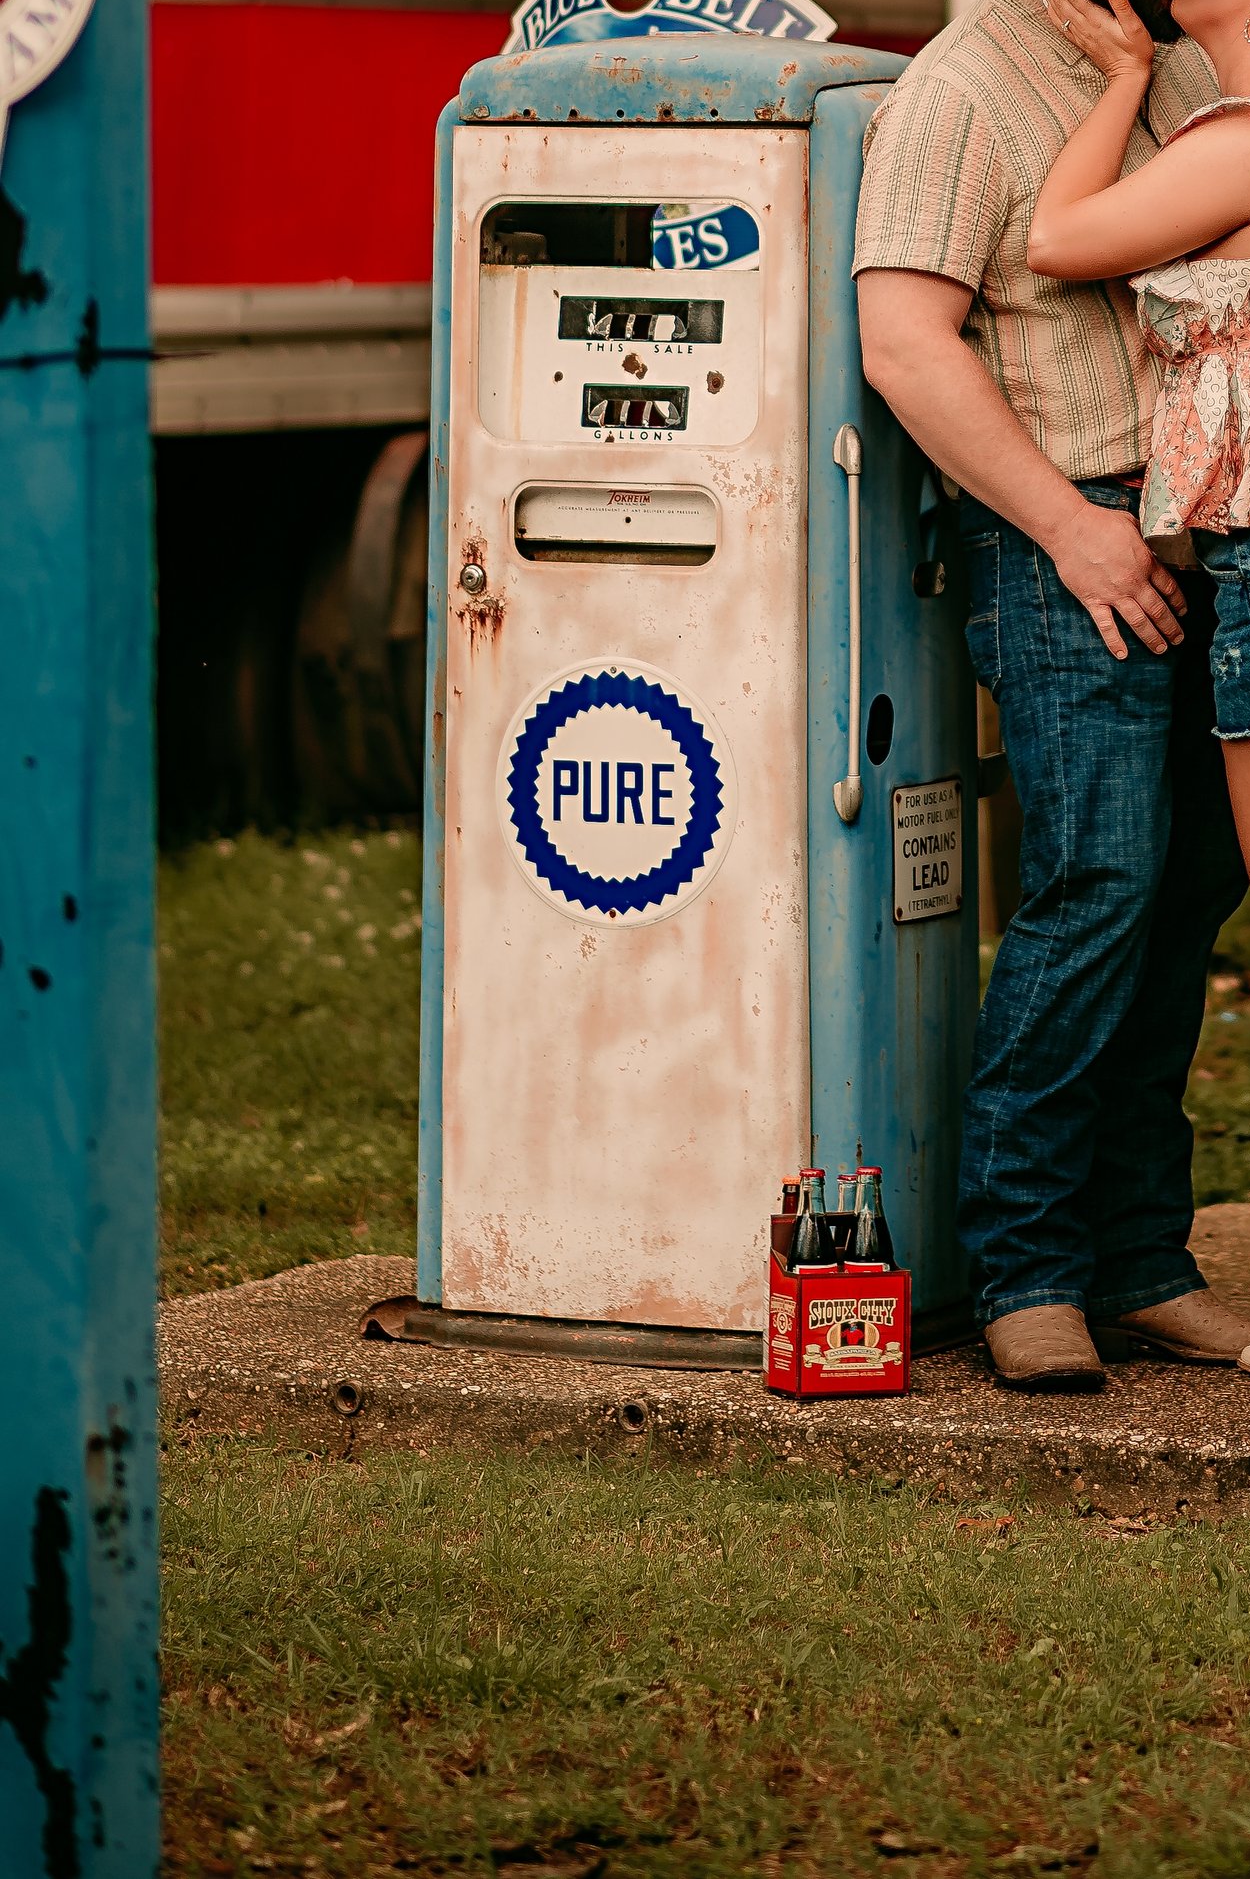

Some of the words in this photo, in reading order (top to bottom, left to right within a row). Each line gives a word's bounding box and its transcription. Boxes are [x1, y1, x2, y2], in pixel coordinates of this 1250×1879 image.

[585, 342, 624, 353] THIS
[653, 344, 694, 354] SALE
[607, 489, 652, 506] TOKHEIM
[552, 759, 675, 826] PURE
[905, 795, 921, 809] FOR
[924, 792, 937, 806] USE
[938, 790, 948, 802] AS
[948, 789, 954, 800] A
[897, 813, 925, 829] MOTOR
[926, 809, 943, 825] FUEL
[944, 807, 960, 821] ONLY
[902, 831, 956, 859] CONTAINS
[912, 861, 950, 891] LEAD
[809, 1299, 857, 1329] SIOUX
[858, 1298, 897, 1326] CITY
